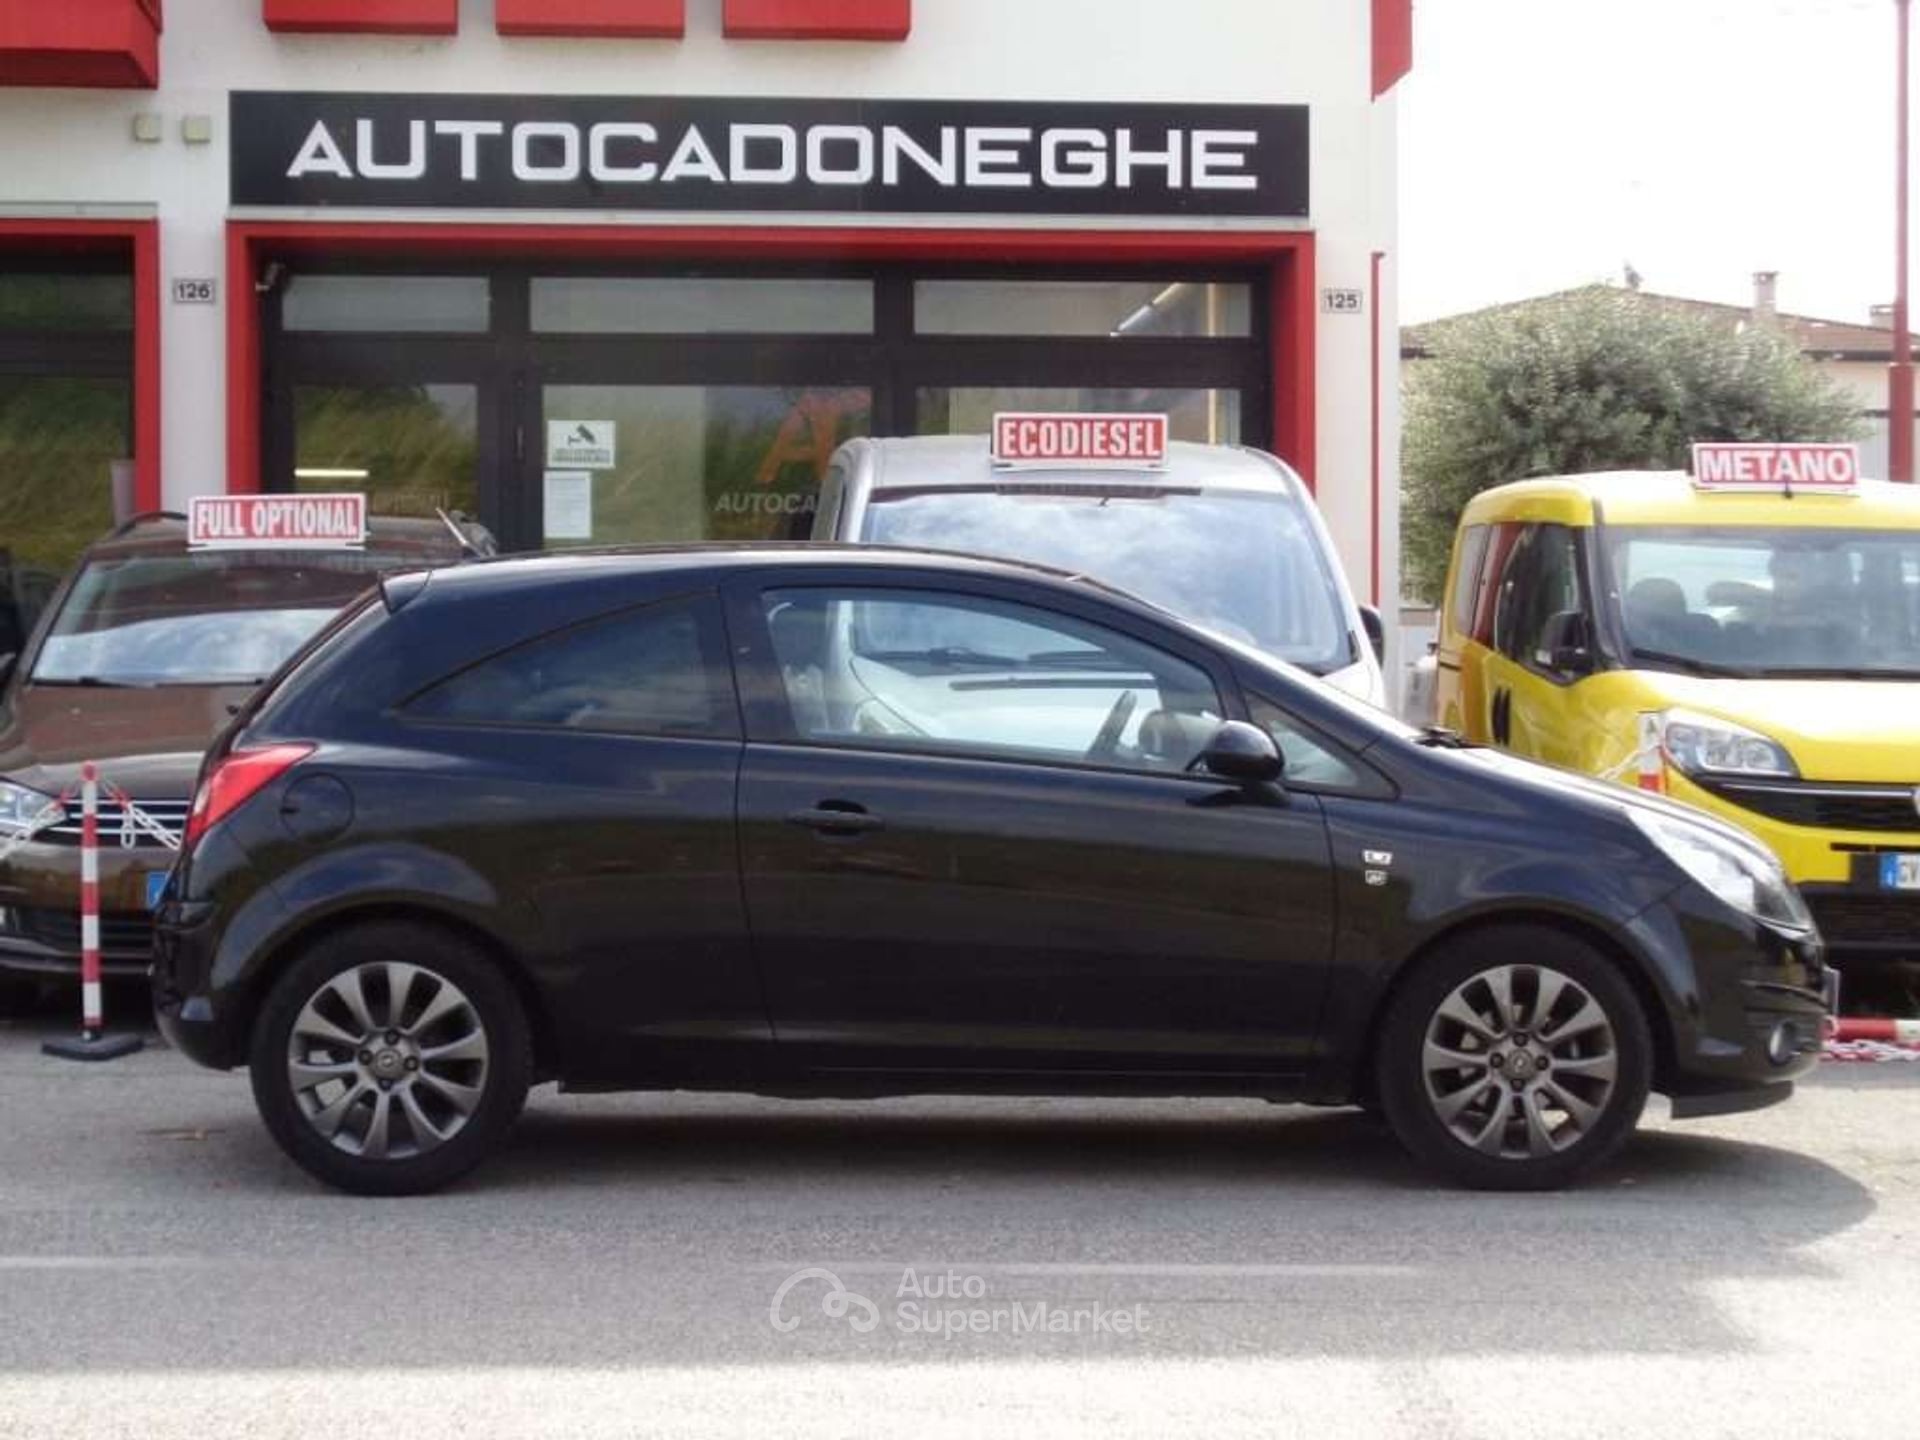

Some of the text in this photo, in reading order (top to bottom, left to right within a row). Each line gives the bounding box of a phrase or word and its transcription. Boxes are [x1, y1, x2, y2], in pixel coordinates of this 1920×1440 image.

[286, 119, 1260, 191] AUTOCADONEGHE
[179, 282, 211, 299] 126
[1327, 293, 1358, 309] 125
[1001, 421, 1161, 457] ECODIESEL
[1700, 448, 1852, 482] METANO
[196, 500, 246, 538] FULL
[250, 498, 359, 537] OPTIONAL
